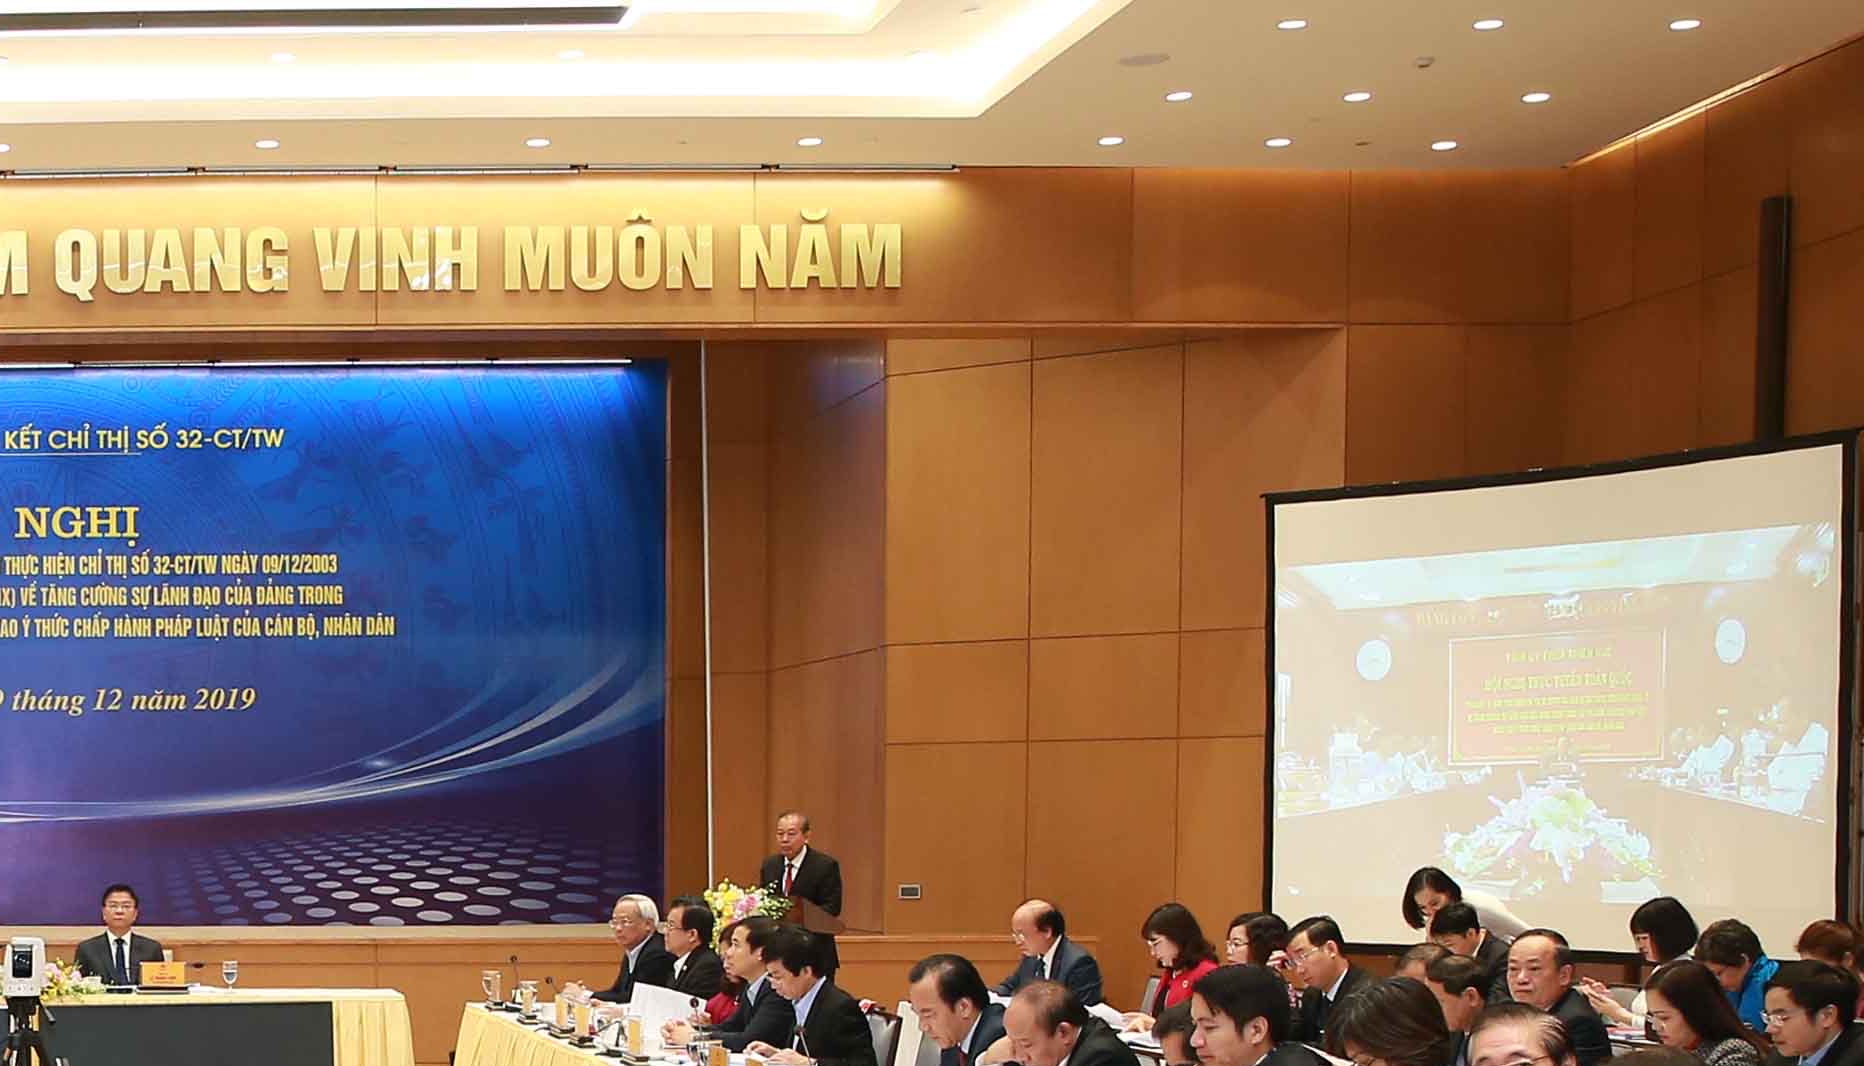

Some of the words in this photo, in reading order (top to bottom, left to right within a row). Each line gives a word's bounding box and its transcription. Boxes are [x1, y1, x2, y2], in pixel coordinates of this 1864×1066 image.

[54, 226, 289, 302] QUANG
[313, 226, 479, 292] VINH
[504, 208, 713, 291] MUÔN
[739, 208, 902, 289] NĂM
[4, 423, 42, 449] KẾT
[47, 423, 90, 449] CHỈ
[96, 426, 129, 454] THỊ
[136, 422, 169, 449] SỐ
[175, 428, 285, 449] 32-CT/TW
[14, 505, 140, 547] NGHỊ
[4, 557, 40, 581] THỰC
[42, 551, 76, 581] HIỆN
[78, 548, 104, 575] CHỈ
[106, 556, 128, 580] THỊ
[130, 548, 150, 575] SỐ
[154, 555, 218, 575] 32-CT/TW
[222, 550, 258, 574] NGÀY
[262, 554, 338, 574] 09/12/2003
[20, 580, 38, 607] VỀ
[40, 583, 76, 607] TĂNG
[80, 582, 128, 607] CƯỜNG
[130, 587, 152, 612] SỰ
[152, 582, 190, 606] LÃNH
[192, 586, 220, 611] ĐẠO
[224, 578, 252, 606] CỦA
[256, 578, 294, 606] ĐẢNG
[298, 586, 344, 605] TRONG
[22, 614, 30, 639] Ý
[34, 614, 70, 639] THỨC
[74, 611, 110, 638] CHẤP
[114, 613, 152, 638] HÀNH
[156, 613, 192, 638] PHÁP
[196, 613, 230, 642] LUẬT
[232, 610, 262, 637] CỦA
[264, 612, 294, 637] CÁN
[296, 612, 320, 642] BỘ,
[324, 612, 362, 636] NHÂN
[366, 612, 394, 636] DÂN
[11, 688, 86, 717] tháng
[92, 688, 123, 711] 12
[131, 689, 187, 711] năm
[193, 687, 256, 710] 2019
